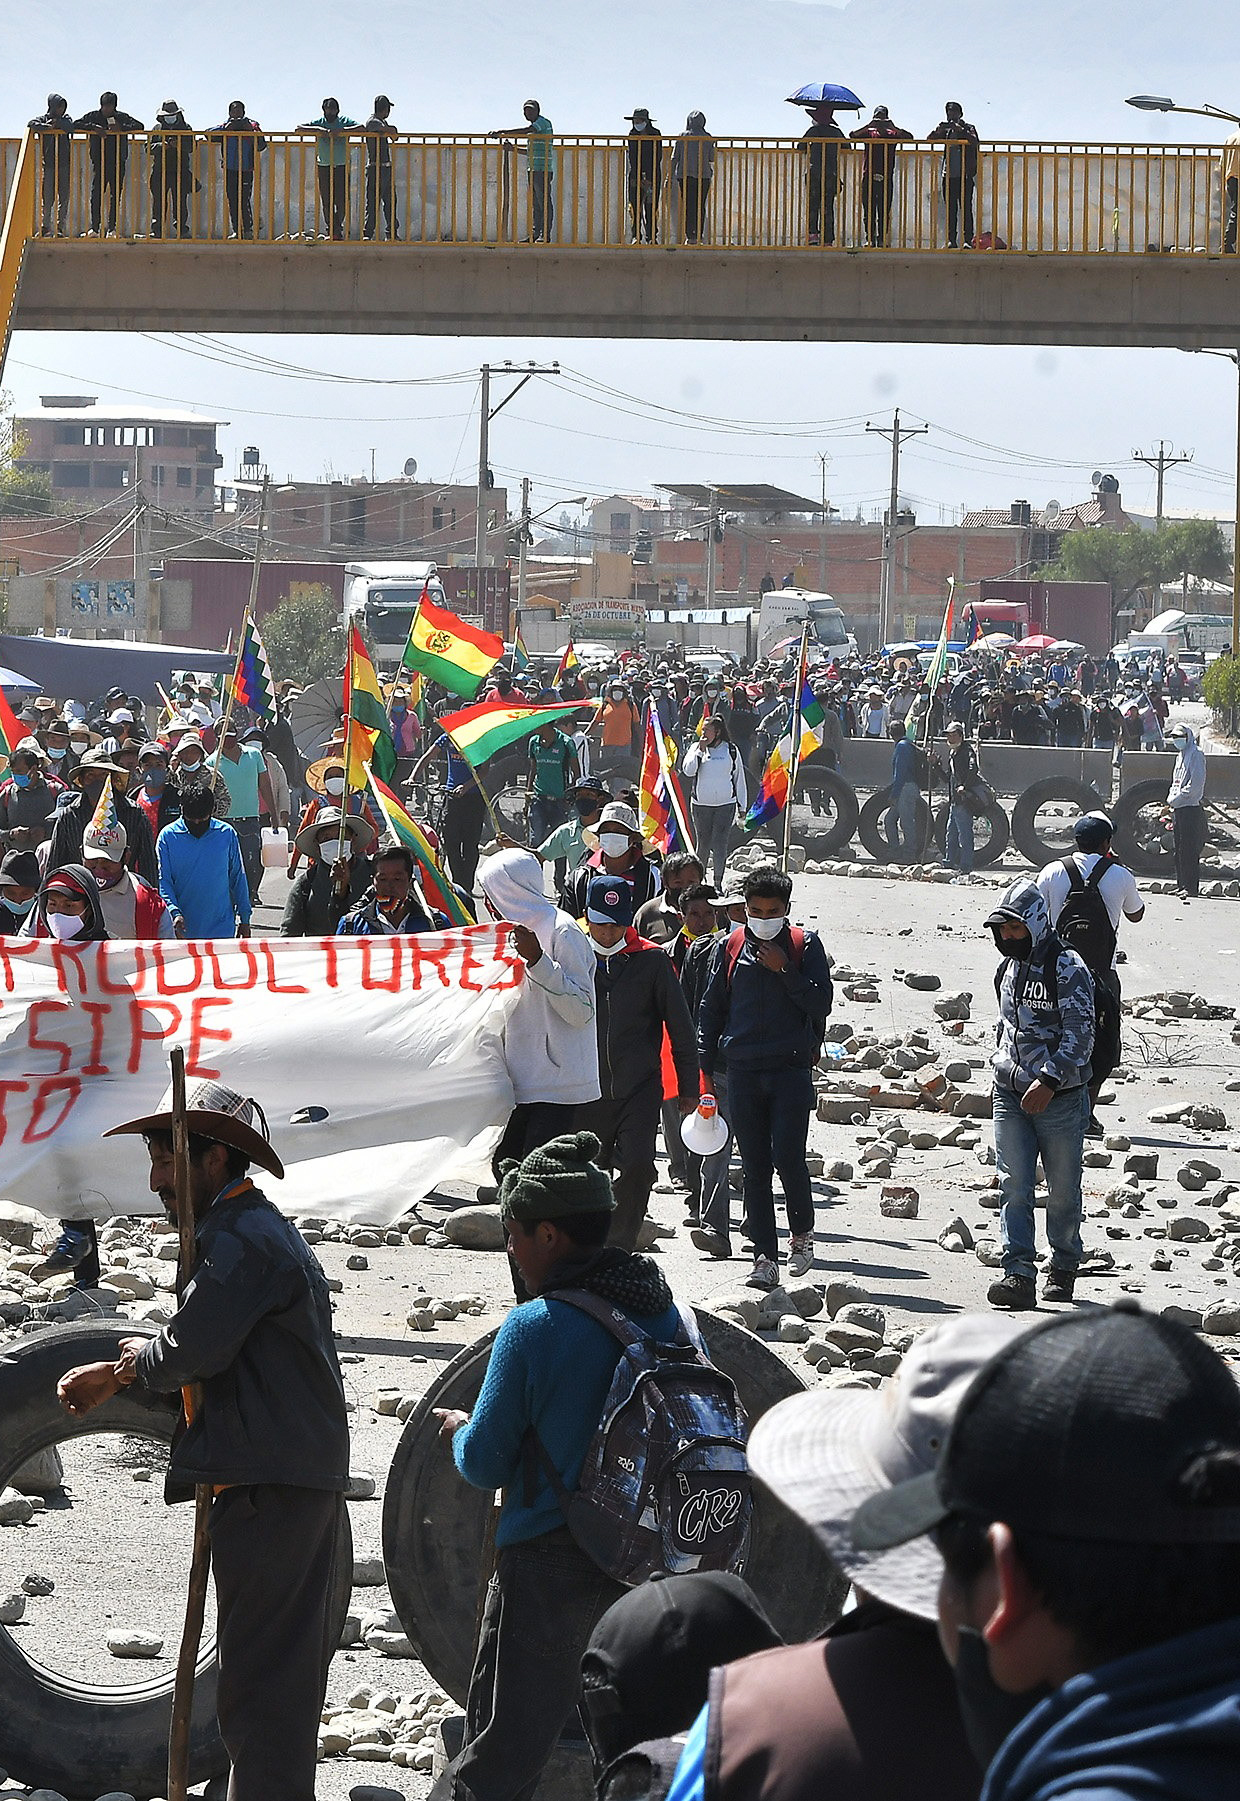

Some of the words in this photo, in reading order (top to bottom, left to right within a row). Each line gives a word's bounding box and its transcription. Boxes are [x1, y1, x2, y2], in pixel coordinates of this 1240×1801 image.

[593, 611, 600, 619] DE
[602, 611, 631, 620] OCTUBRE
[1023, 998, 1053, 1010] BOSTON
[22, 997, 234, 1080] SIPE
[678, 1488, 742, 1543] CR2
